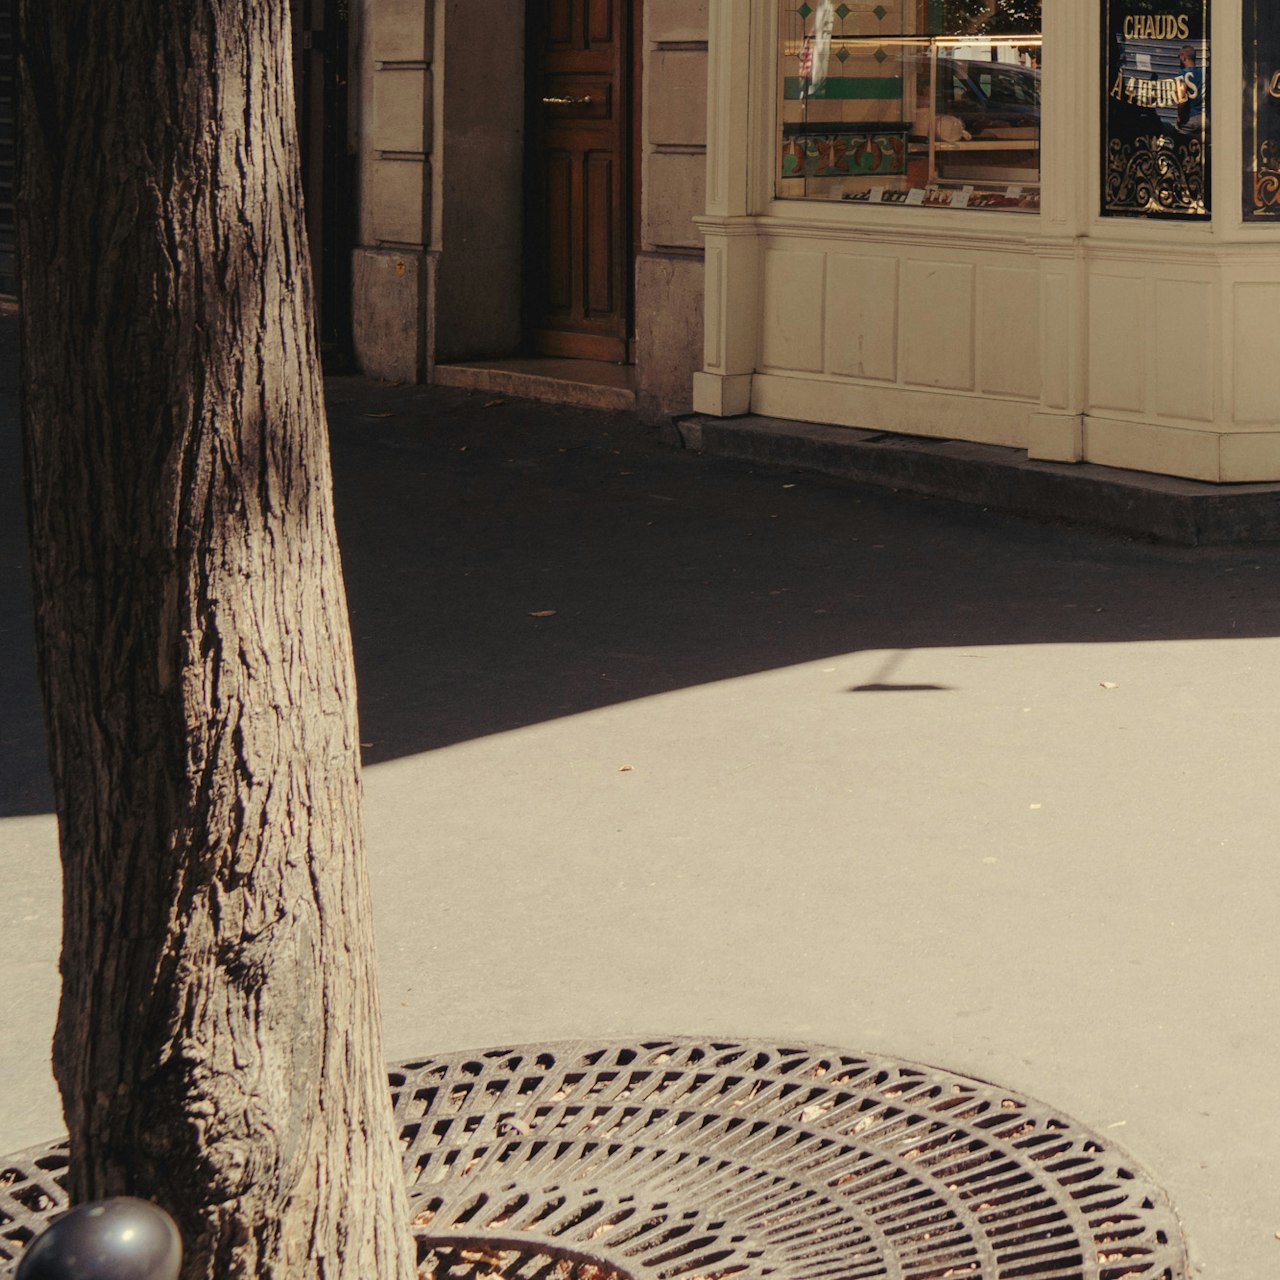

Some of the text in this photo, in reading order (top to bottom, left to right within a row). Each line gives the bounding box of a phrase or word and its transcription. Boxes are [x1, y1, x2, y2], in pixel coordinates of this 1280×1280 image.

[1123, 15, 1189, 40] CHAUDS
[1125, 76, 1136, 104] 4
[1136, 71, 1199, 108] HEURES
